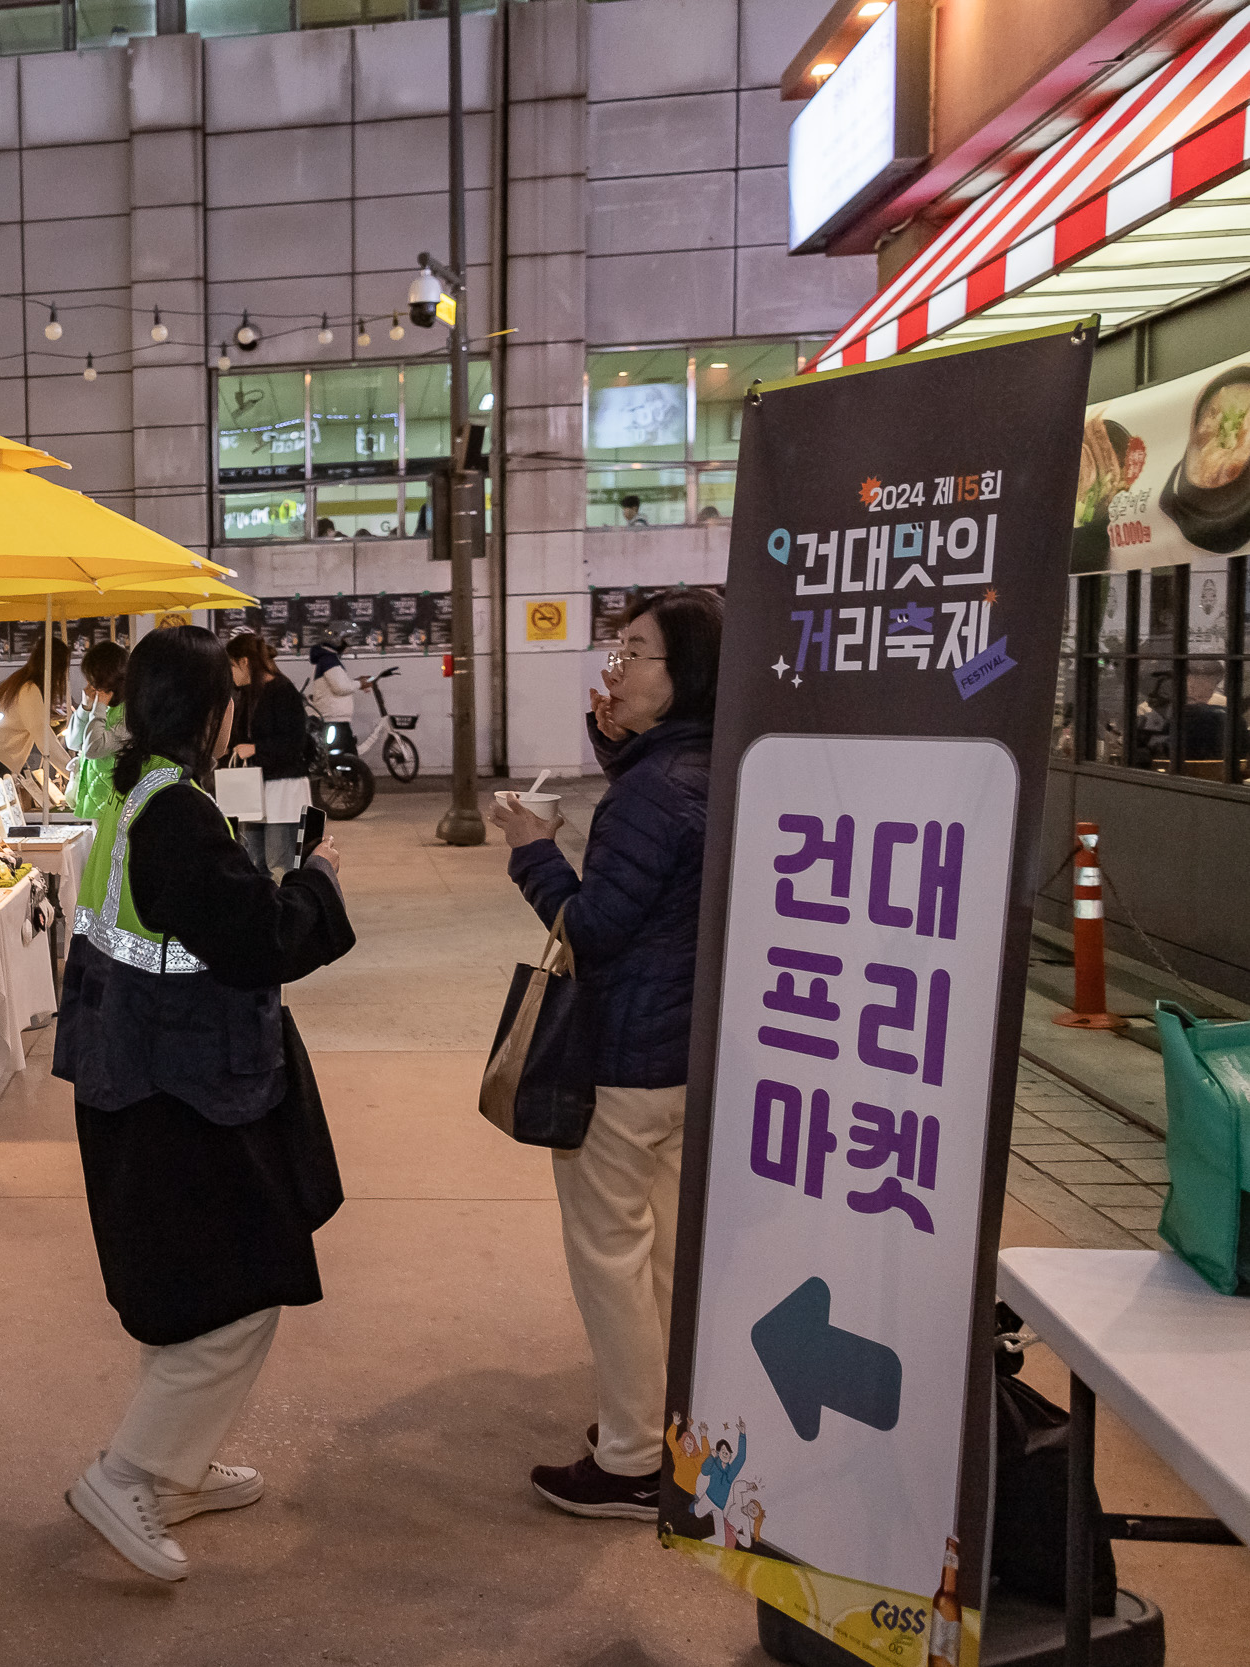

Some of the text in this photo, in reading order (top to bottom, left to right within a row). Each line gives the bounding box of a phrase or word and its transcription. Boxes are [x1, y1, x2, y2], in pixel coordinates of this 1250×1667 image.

[868, 469, 1002, 513] 2024 제15회
[959, 654, 1008, 690] FESTIVAL
[773, 813, 965, 940] 건대
[757, 946, 951, 1088] 프리
[750, 1078, 940, 1235] 마켓
